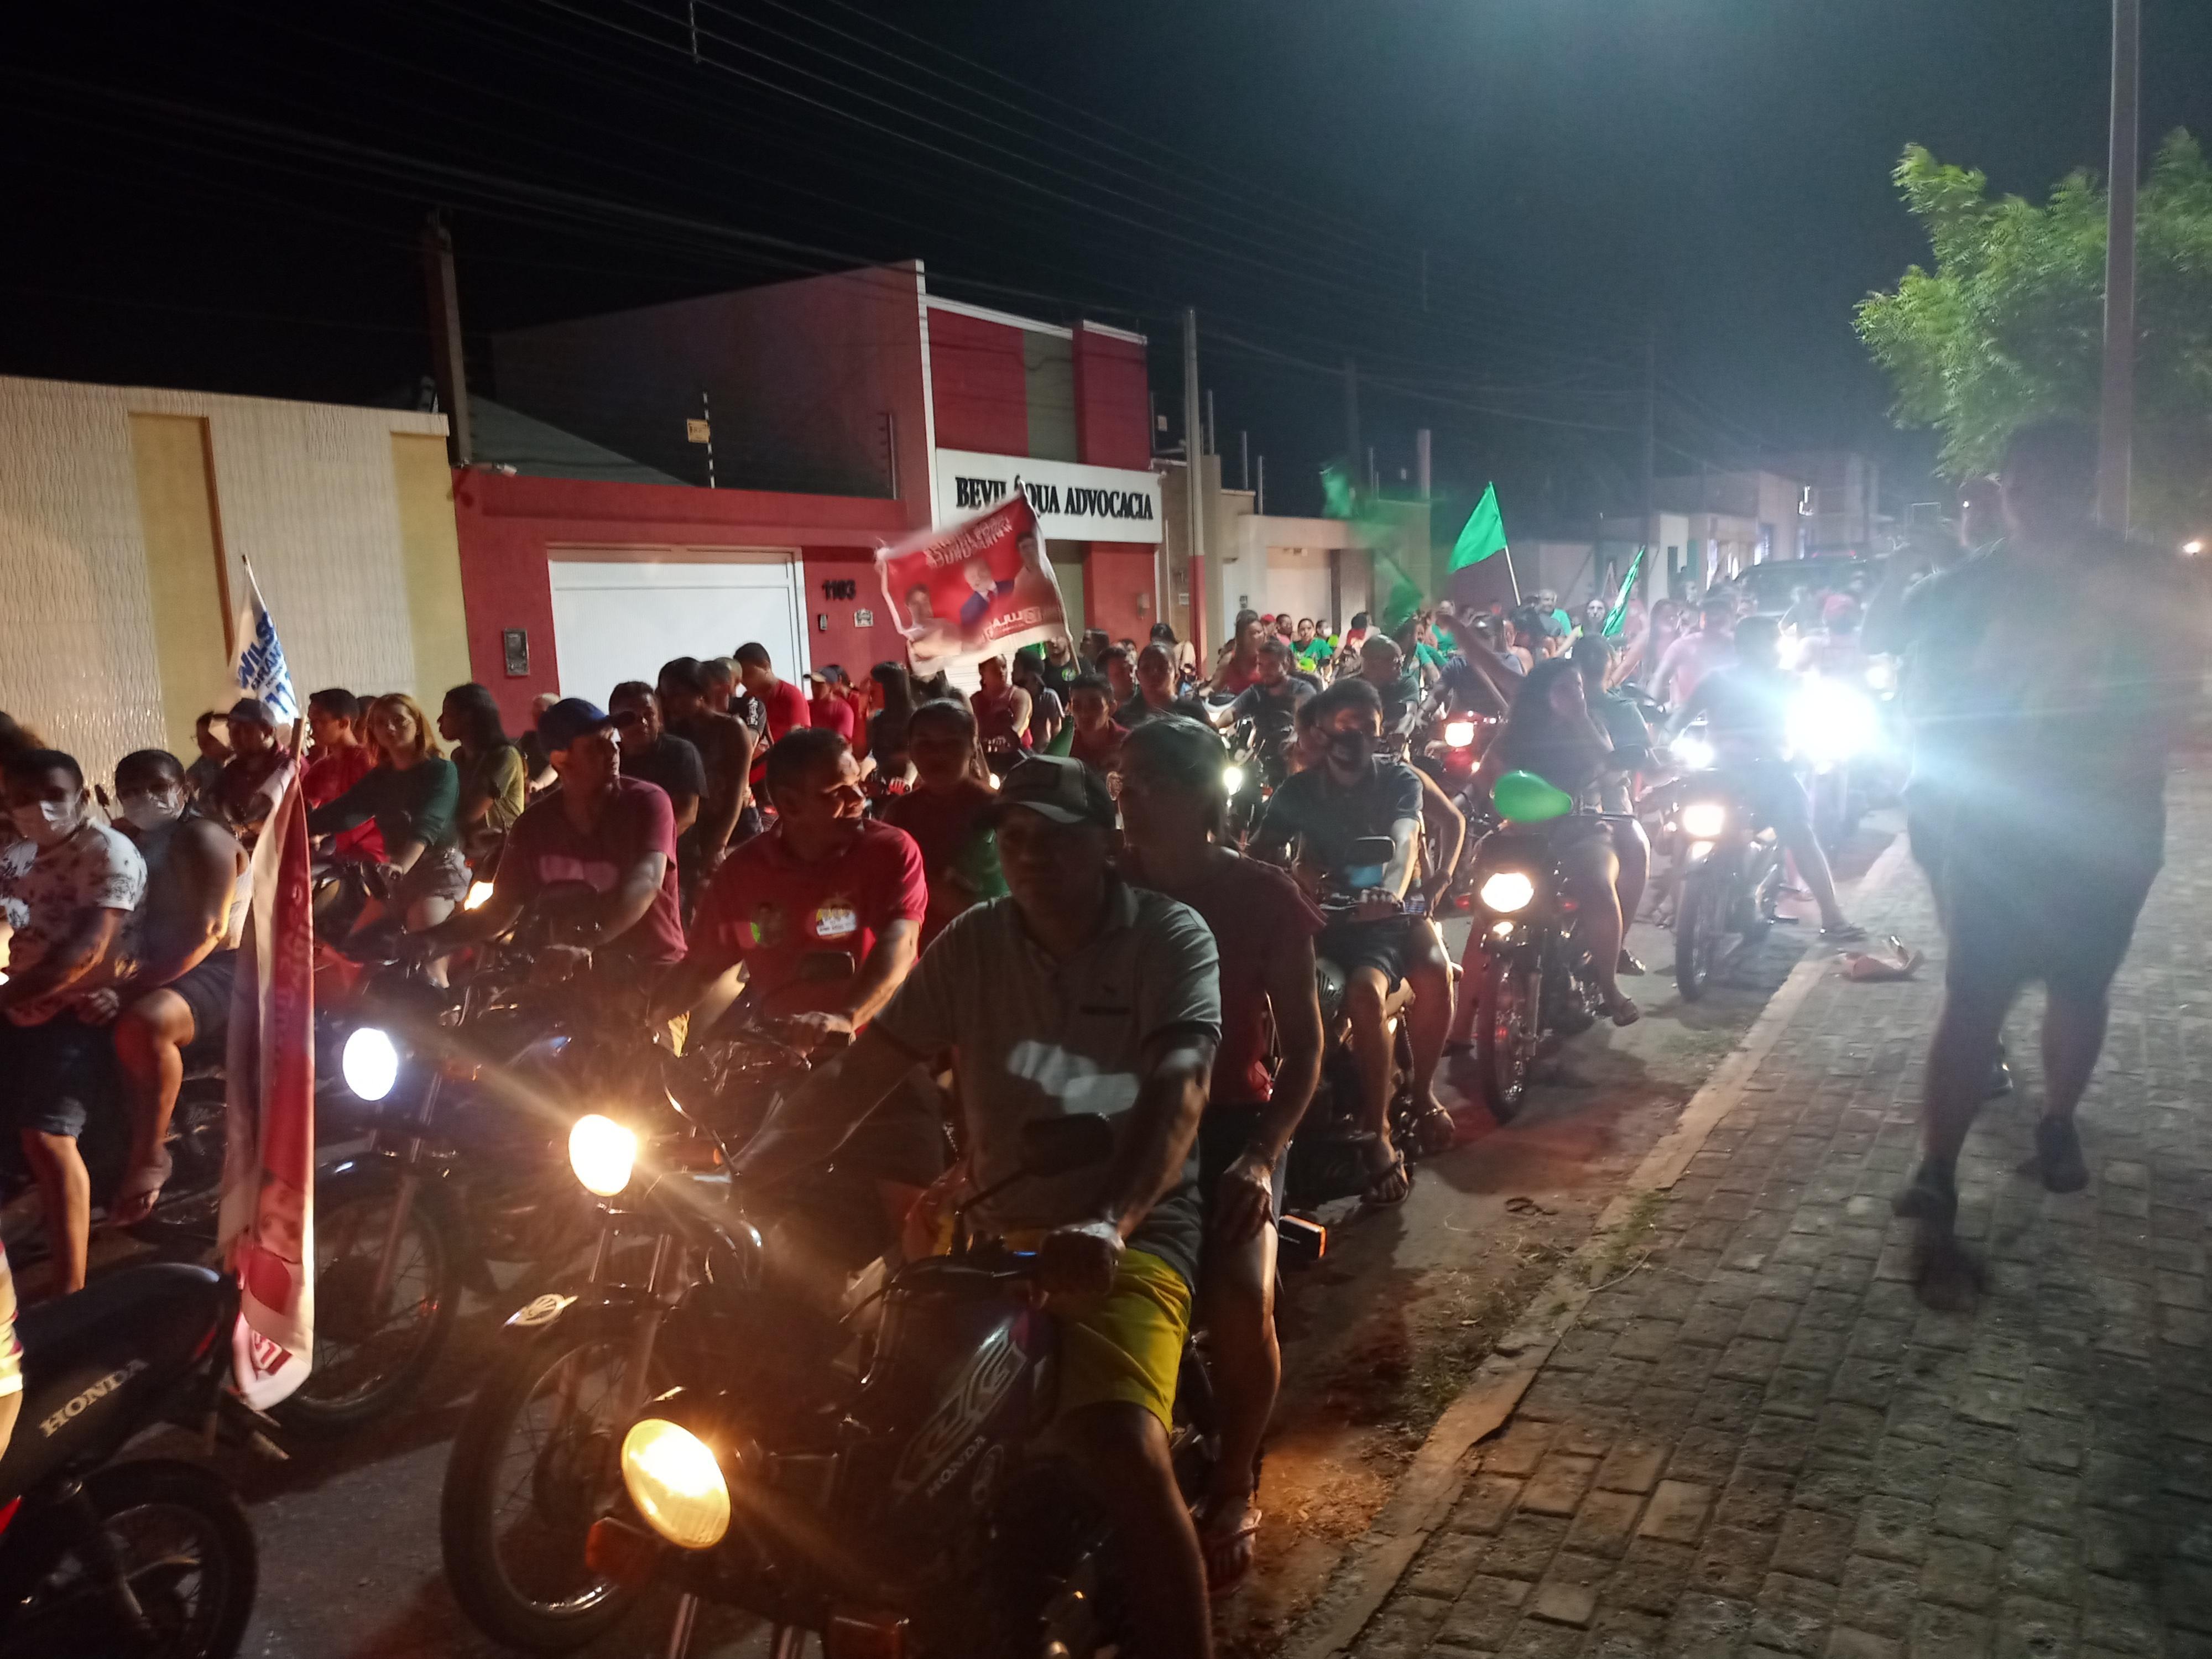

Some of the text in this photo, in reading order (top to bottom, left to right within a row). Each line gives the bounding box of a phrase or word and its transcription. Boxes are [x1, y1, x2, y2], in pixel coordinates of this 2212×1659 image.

[1064, 487, 1154, 520] ADVOCACIA
[39, 1359, 148, 1438] HONDA
[926, 1434, 987, 1498] HONDA
